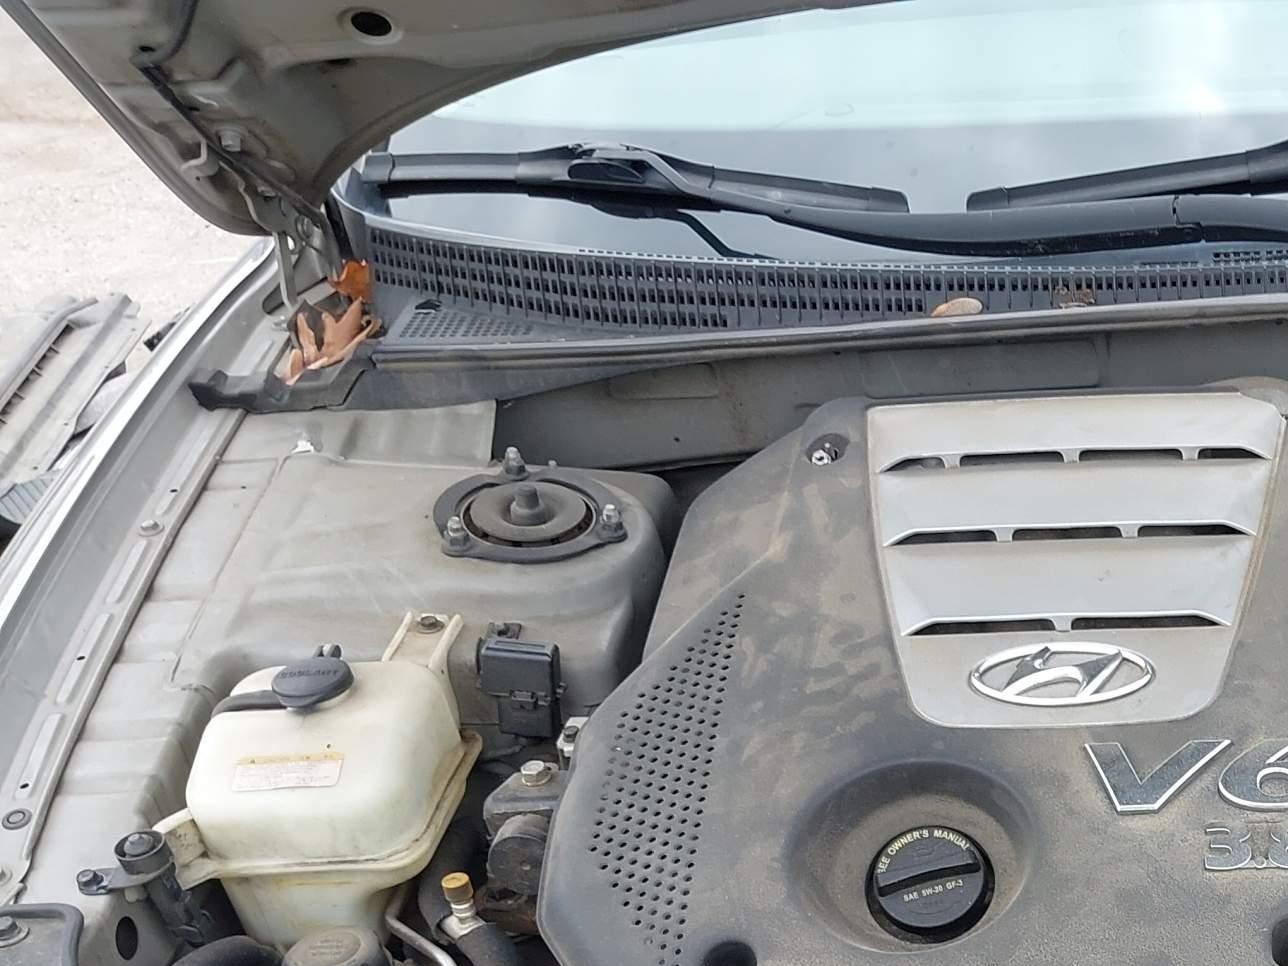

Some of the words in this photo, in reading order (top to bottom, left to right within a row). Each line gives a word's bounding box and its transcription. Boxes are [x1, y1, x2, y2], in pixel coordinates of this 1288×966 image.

[888, 829, 929, 855] OWNER'S
[934, 829, 970, 851] MANUAL
[903, 890, 919, 902] SAE
[946, 880, 963, 890] GF-3
